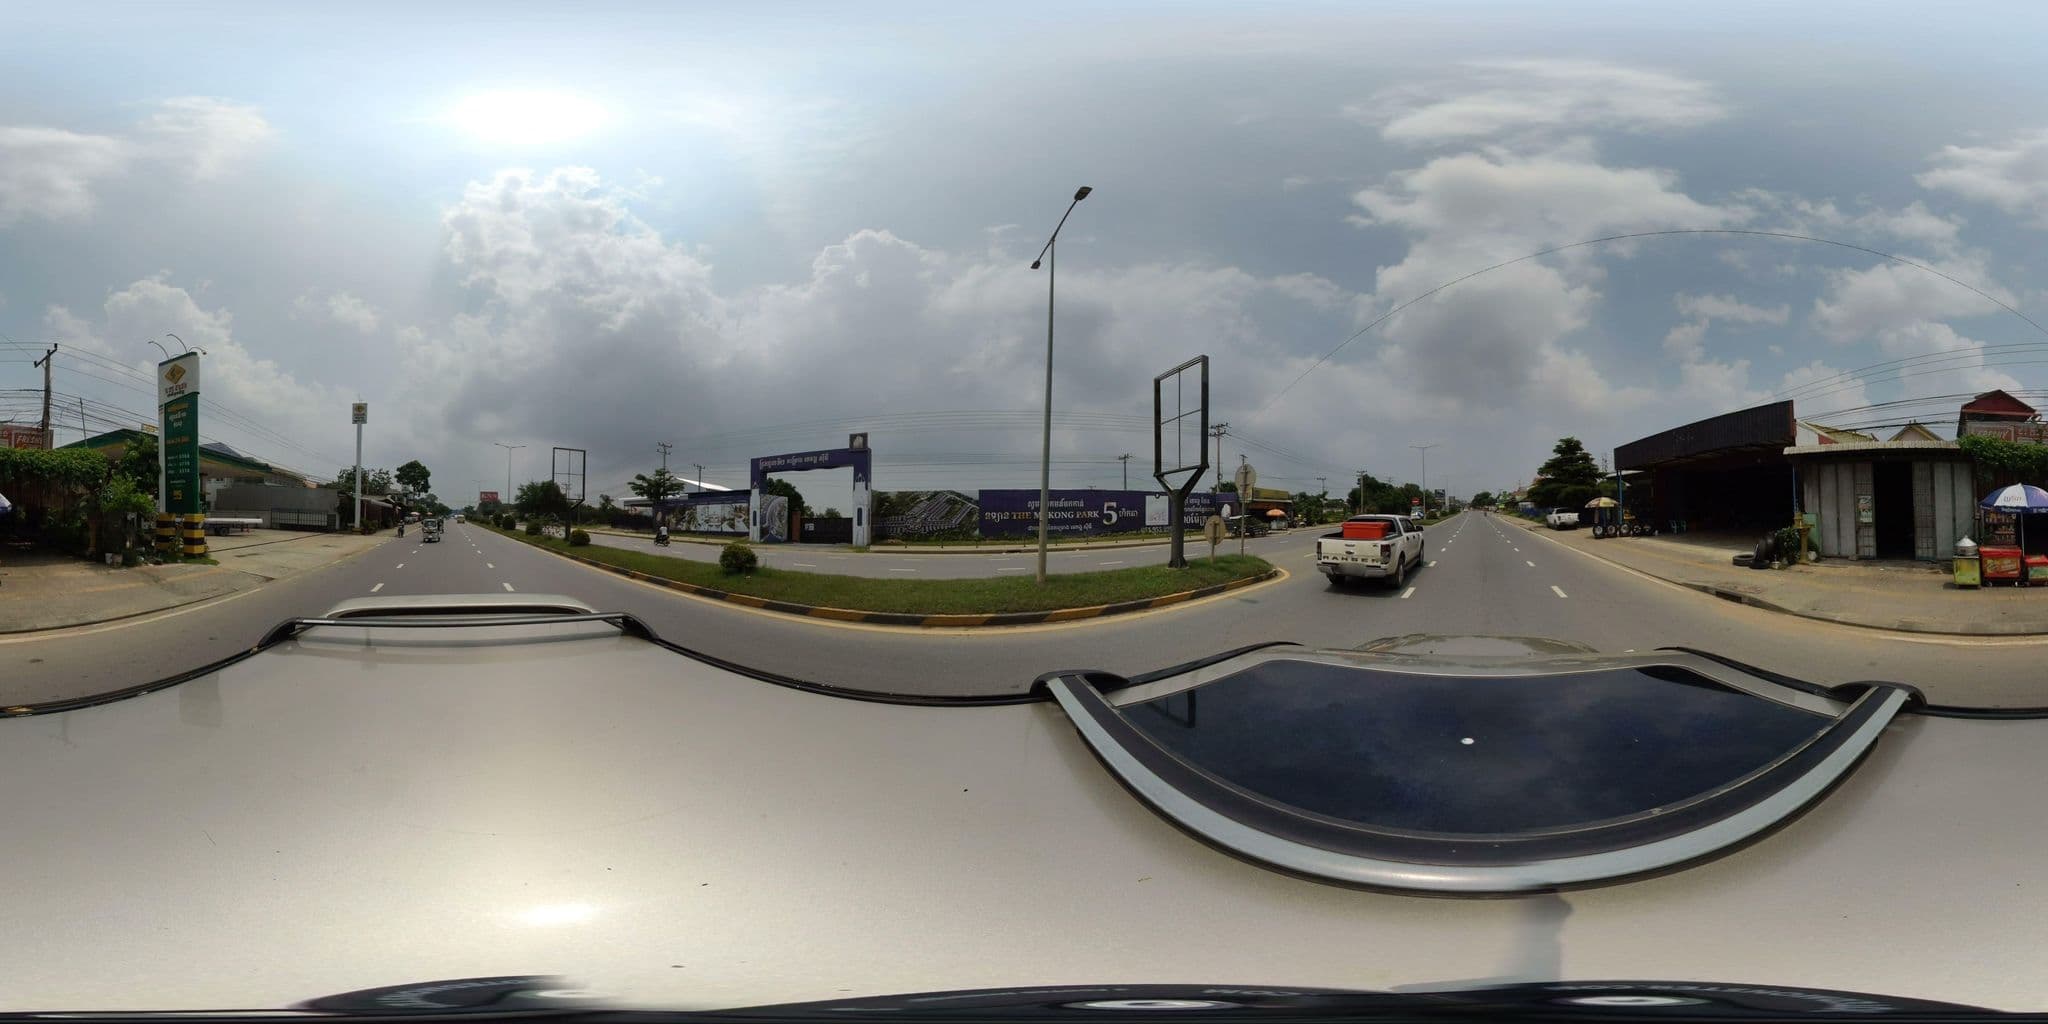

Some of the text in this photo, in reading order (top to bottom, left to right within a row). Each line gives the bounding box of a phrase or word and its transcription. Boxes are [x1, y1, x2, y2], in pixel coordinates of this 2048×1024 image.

[1011, 511, 1031, 520] THE
[1033, 511, 1074, 520] MKONG
[1076, 510, 1101, 519] PARK
[1103, 501, 1118, 526] 5
[1323, 555, 1380, 564] RANGER
